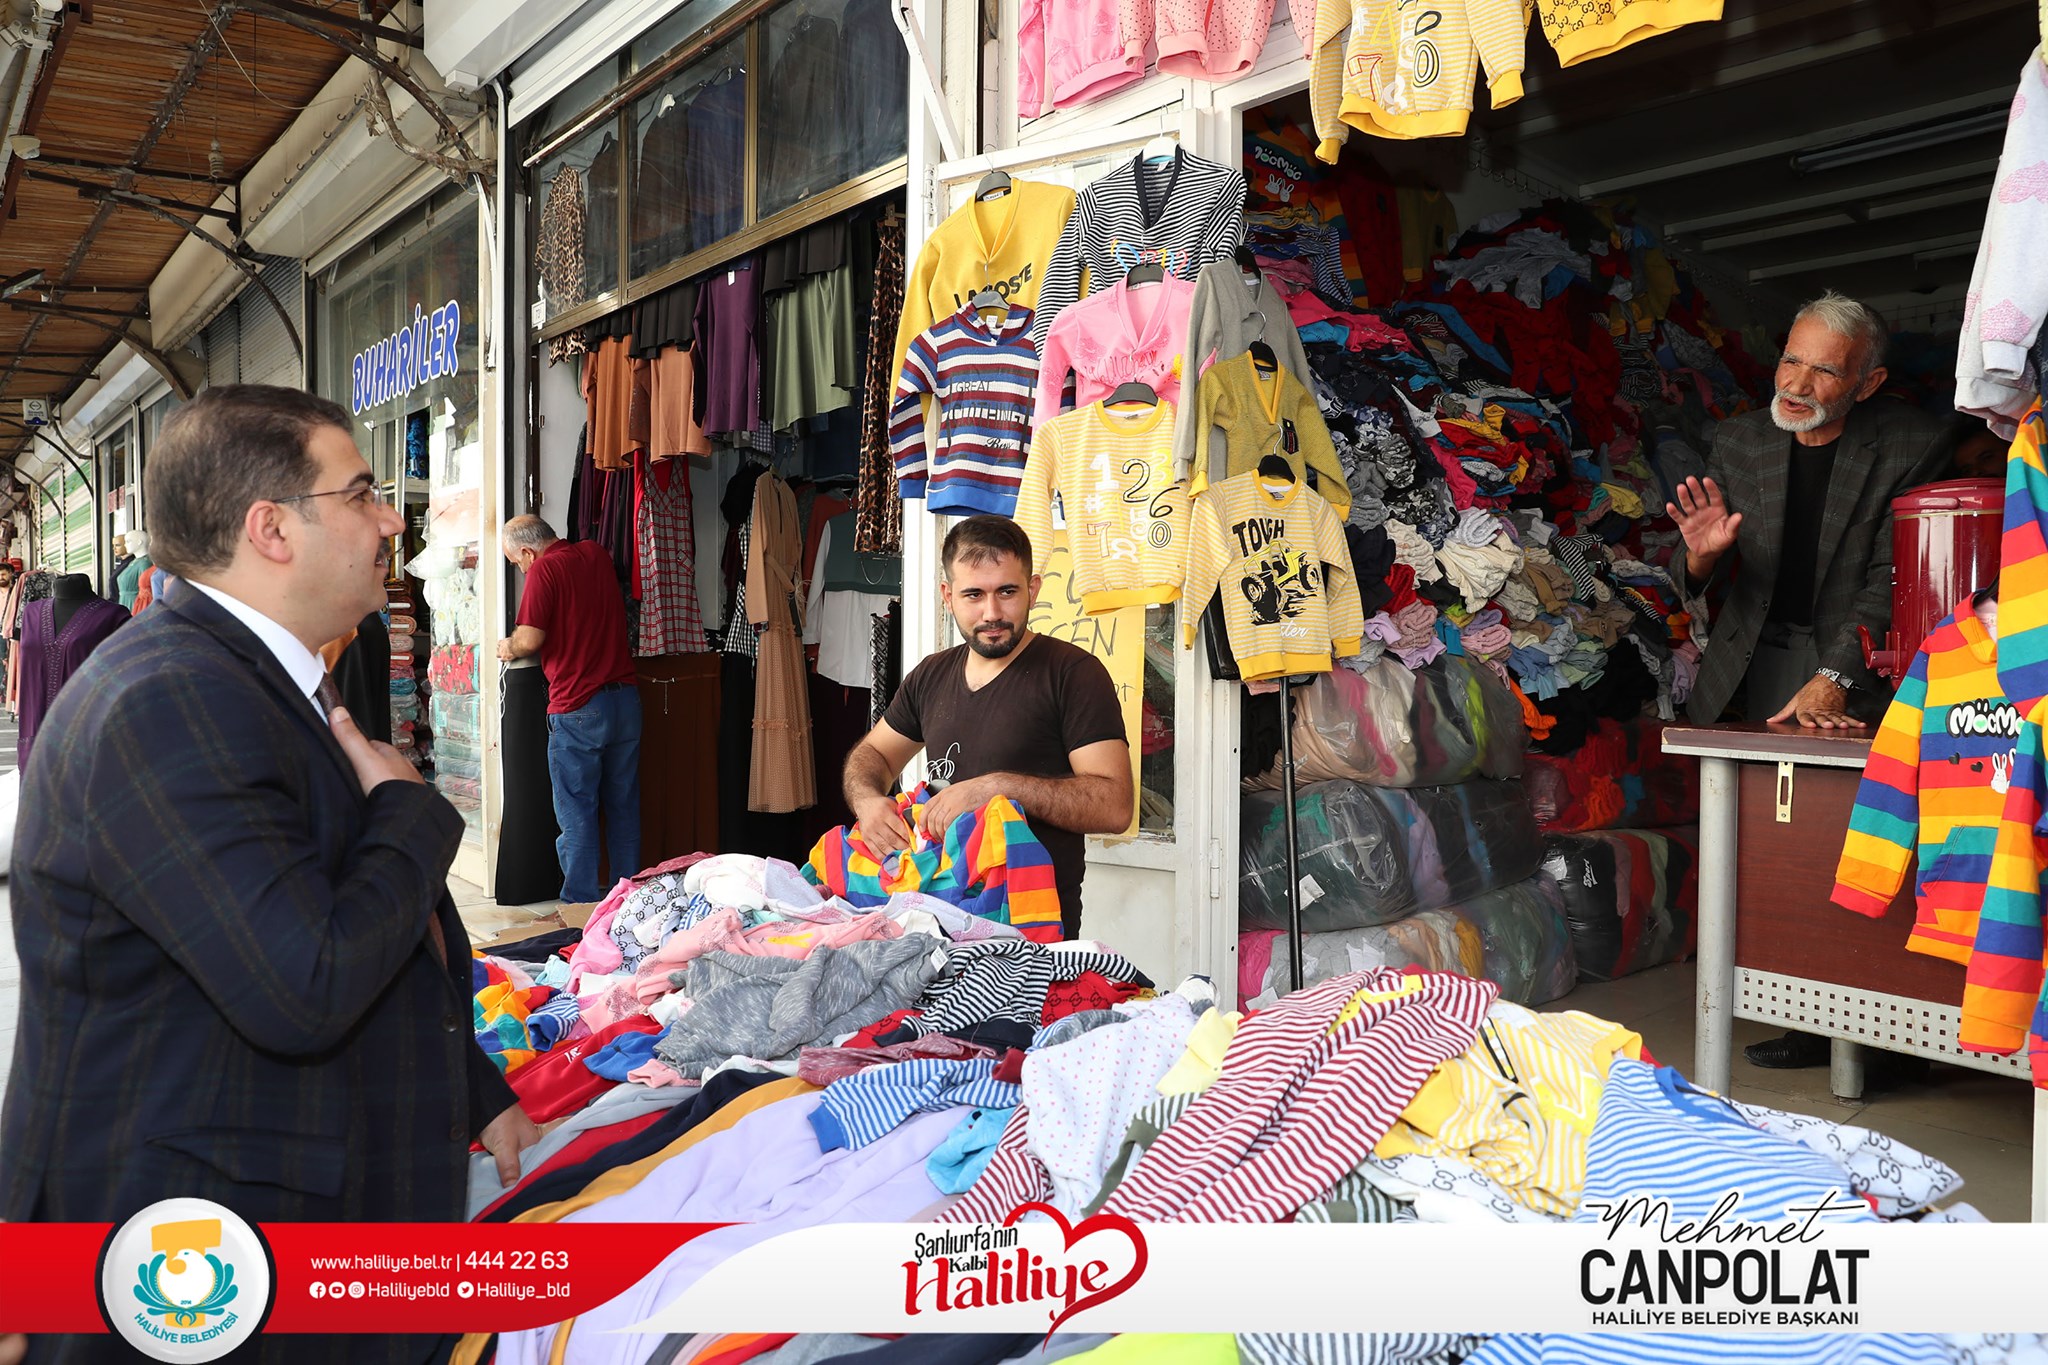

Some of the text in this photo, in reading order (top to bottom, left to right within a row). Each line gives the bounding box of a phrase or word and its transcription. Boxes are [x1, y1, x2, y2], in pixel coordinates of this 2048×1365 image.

[352, 299, 460, 417] BUHARİLER
[955, 380, 991, 394] GREAT
[1122, 458, 1151, 503] 2
[1149, 486, 1181, 518] 6
[1086, 521, 1112, 559] 7
